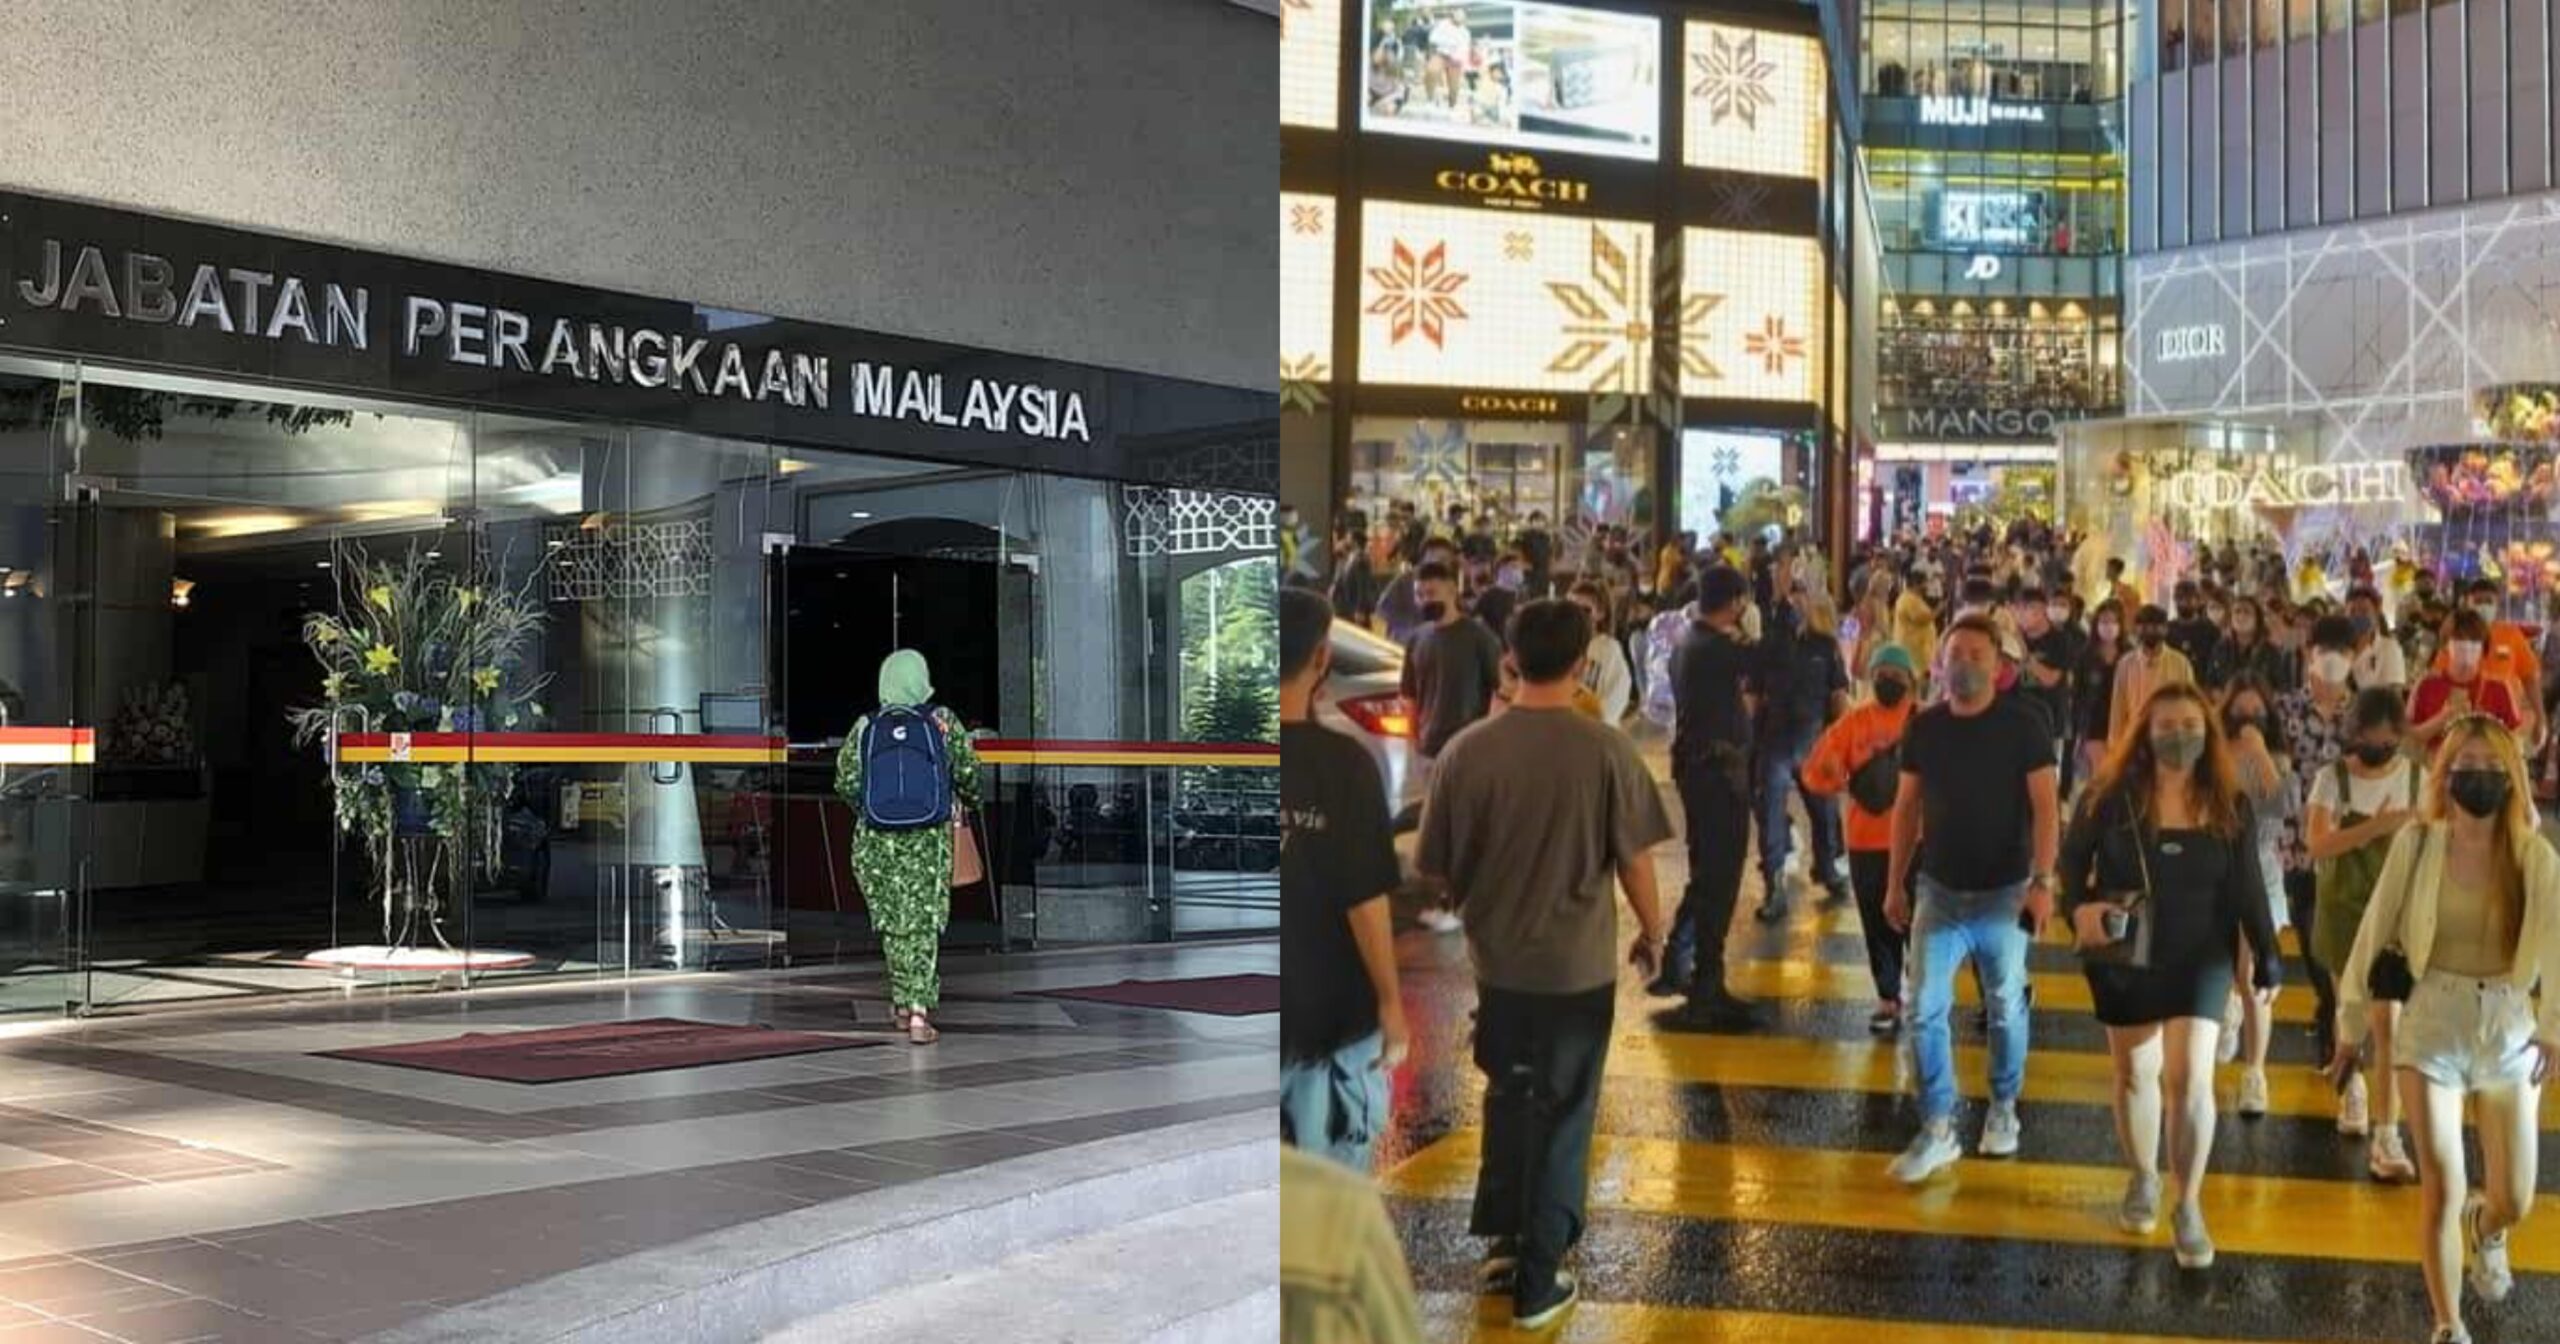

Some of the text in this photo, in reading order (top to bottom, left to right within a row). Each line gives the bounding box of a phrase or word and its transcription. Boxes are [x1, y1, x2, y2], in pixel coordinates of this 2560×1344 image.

[1920, 96, 1988, 126] MUJI
[1436, 170, 1588, 202] COACH
[1964, 254, 2000, 279] JD
[17, 239, 1091, 442] JABATAN PERANGKAAN MALAYSIA
[2157, 323, 2225, 362] DIOR
[1460, 395, 1558, 413] COACH
[1906, 408, 2056, 437] MANGO
